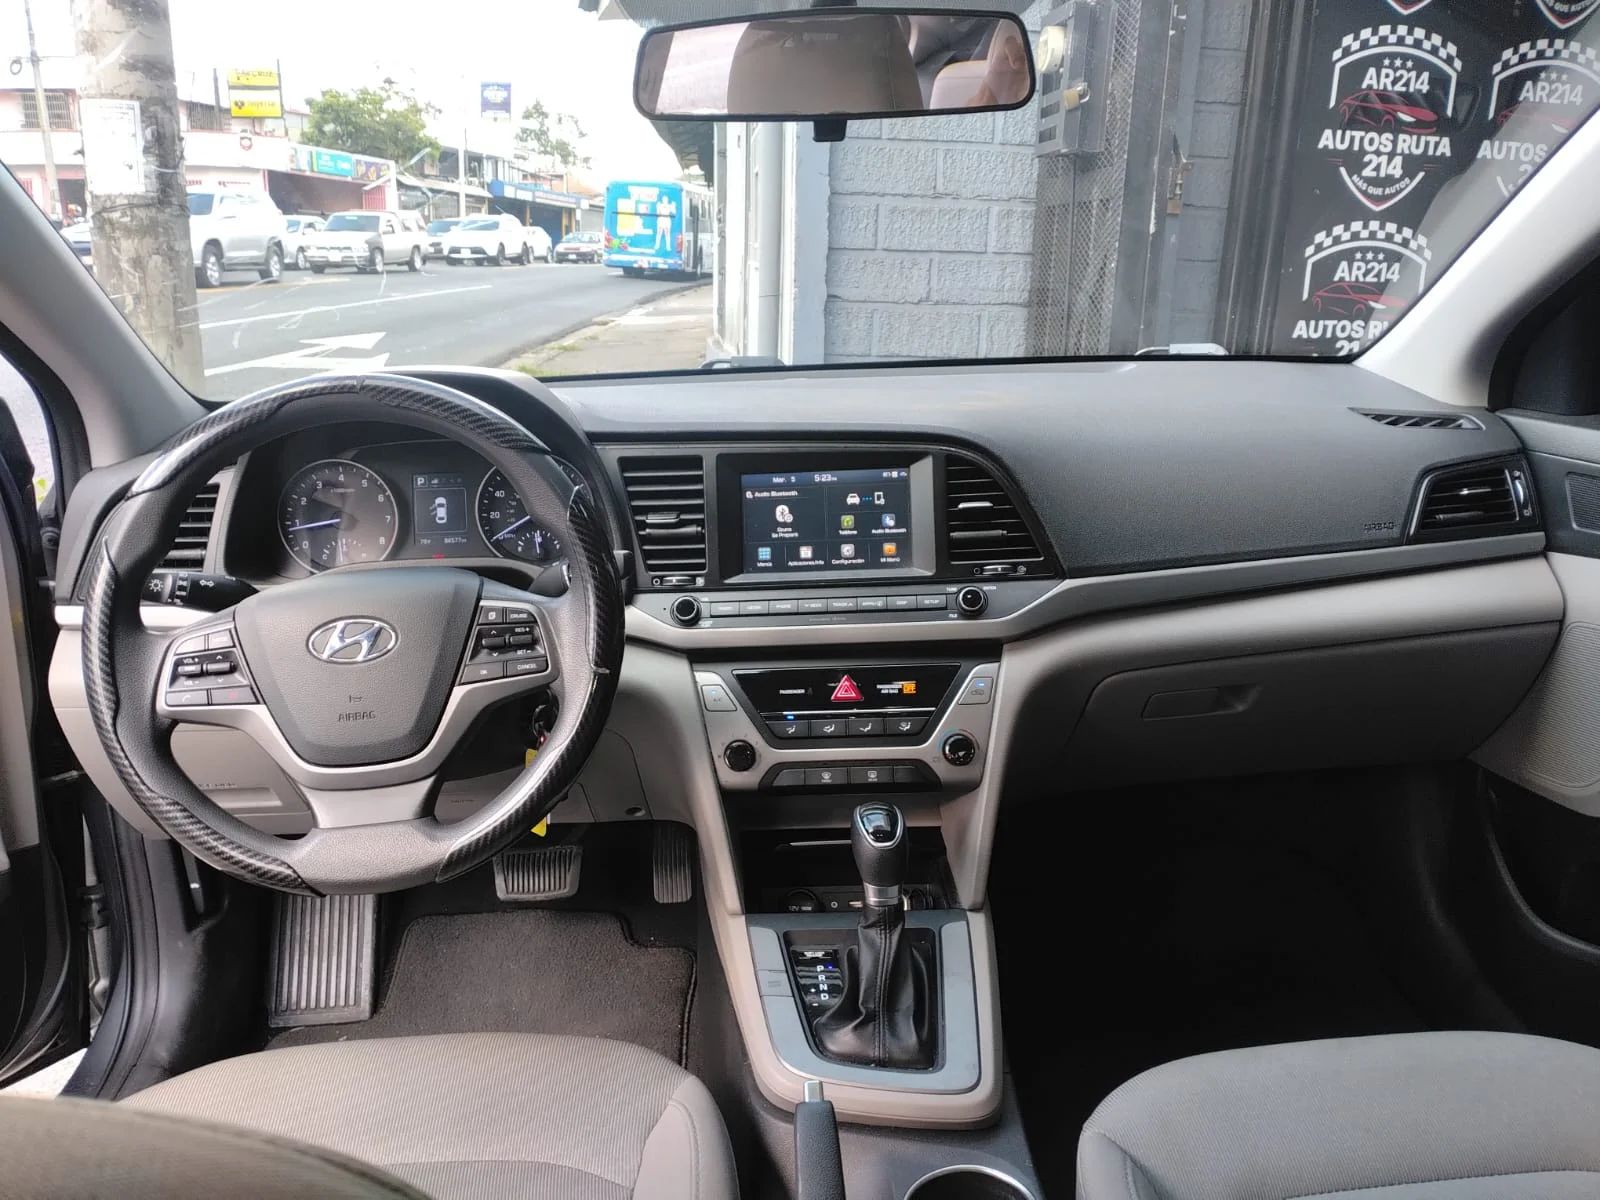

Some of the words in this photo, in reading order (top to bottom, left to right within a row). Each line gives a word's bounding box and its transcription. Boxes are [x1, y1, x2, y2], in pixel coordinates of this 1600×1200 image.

[1361, 66, 1430, 94] AR214
[1519, 80, 1584, 106] AR214
[1318, 128, 1394, 153] AUTOS
[1396, 133, 1452, 157] RUTA
[1476, 139, 1549, 163] AUTOS
[1361, 153, 1404, 179] 214
[1367, 185, 1384, 196] QUE
[1384, 176, 1412, 196] AUTOS
[1333, 260, 1401, 283] AR214
[1291, 319, 1366, 340] AUTOS
[338, 473, 345, 481] 4
[416, 477, 425, 486] P
[315, 480, 323, 489] 3
[361, 479, 368, 488] 5
[494, 489, 505, 498] 40
[301, 497, 308, 505] 2
[378, 494, 385, 503] 6
[385, 515, 391, 523] 7
[489, 511, 500, 519] 20
[302, 541, 309, 549] 0
[379, 536, 386, 545] 8
[337, 710, 377, 722] AIRBAG
[816, 965, 824, 973] P
[818, 974, 826, 982] R
[819, 983, 828, 991] N
[820, 992, 829, 1000] D
